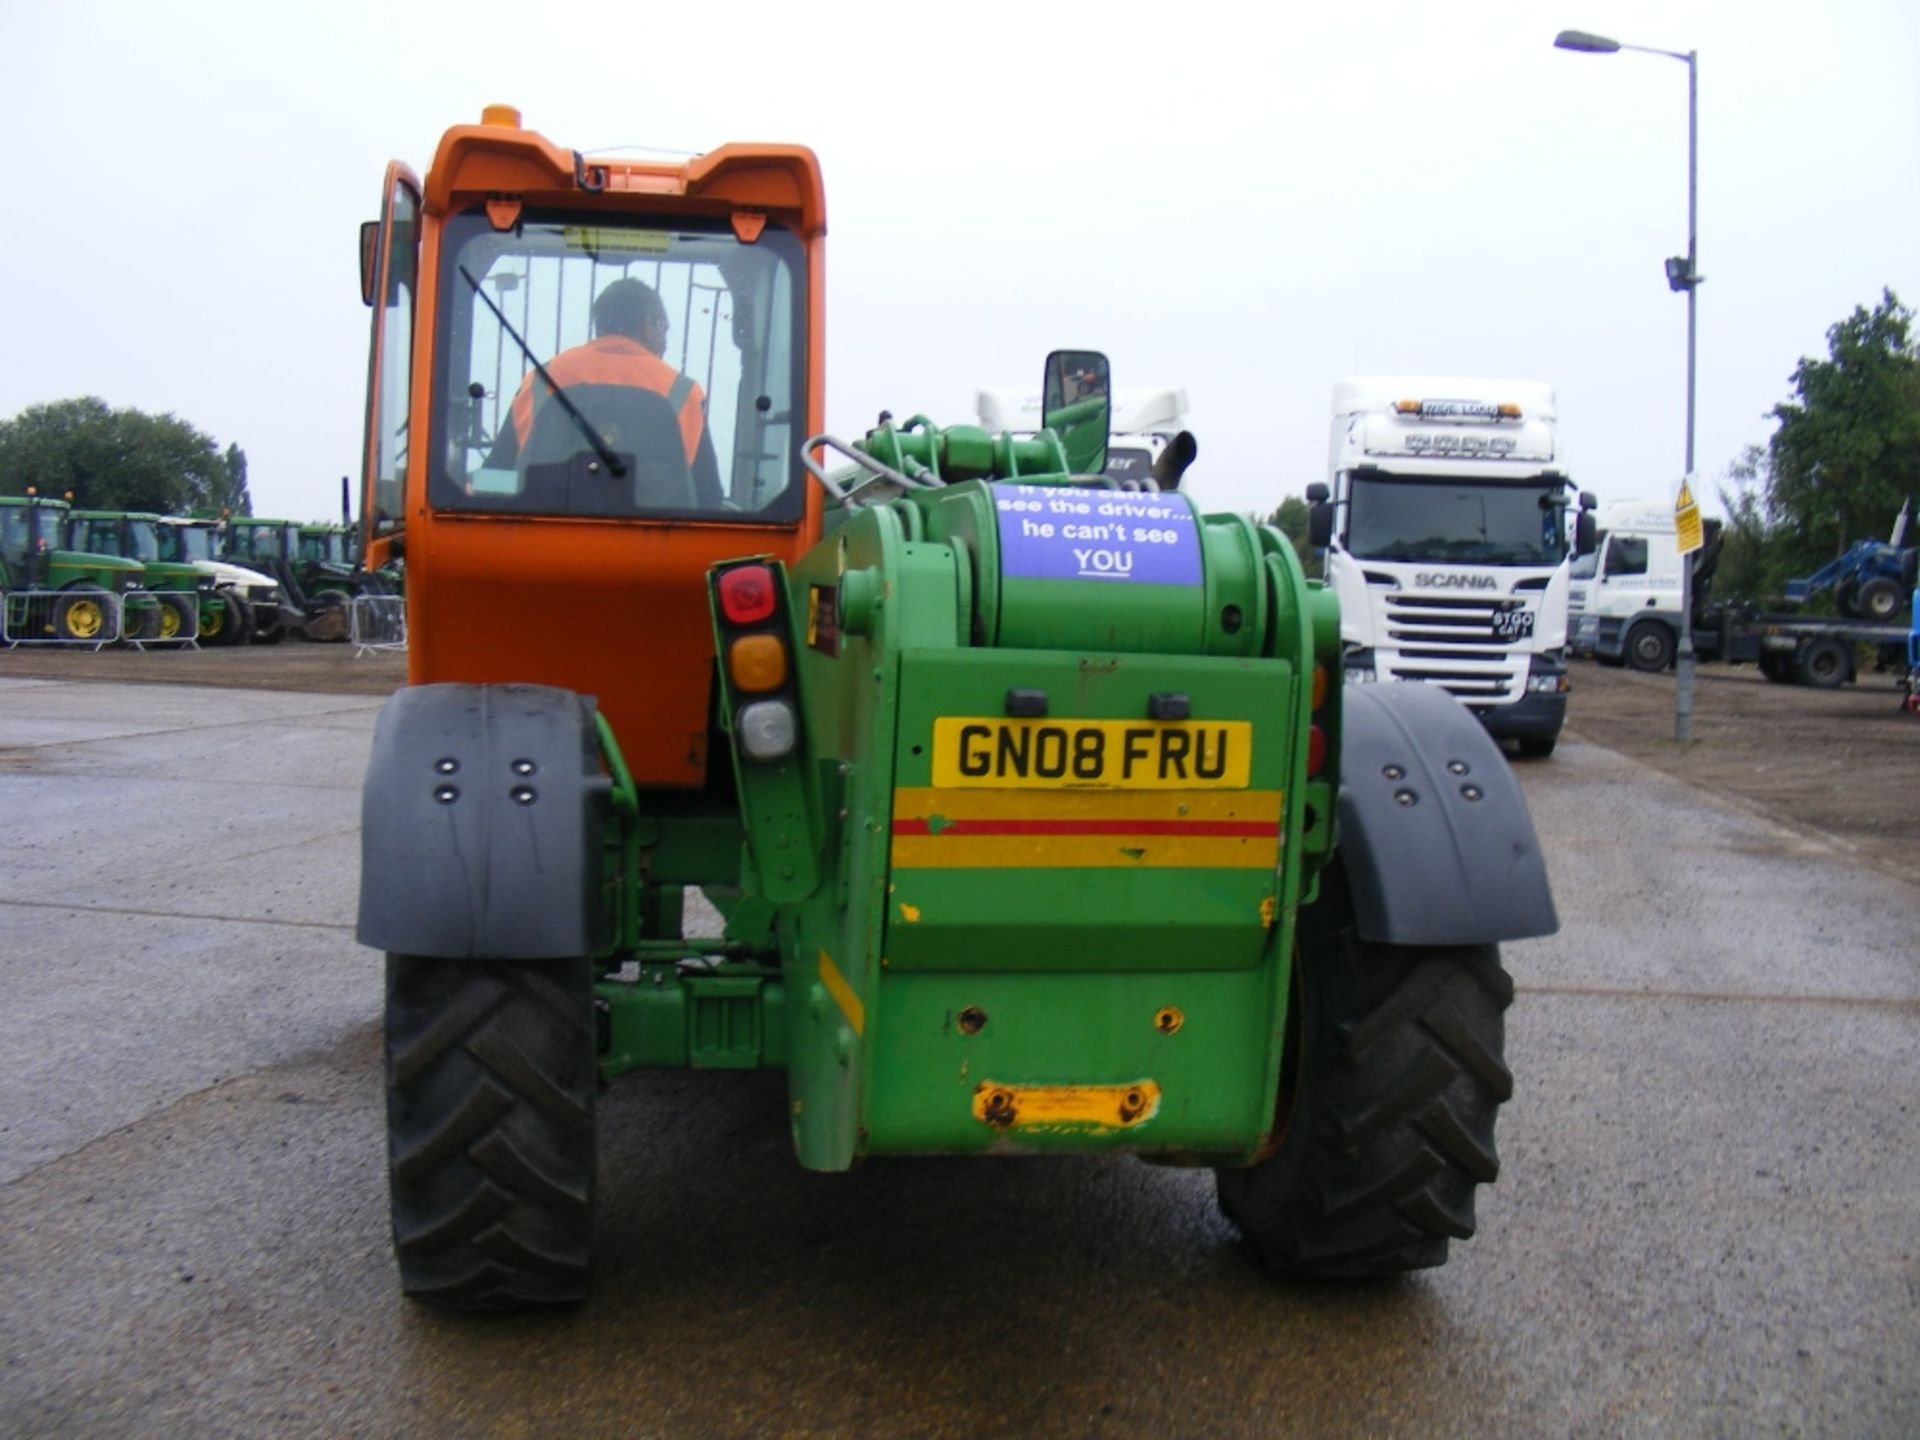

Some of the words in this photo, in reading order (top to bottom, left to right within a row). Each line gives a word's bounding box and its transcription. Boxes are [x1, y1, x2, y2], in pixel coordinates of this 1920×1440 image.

[998, 500, 1042, 512] see
[1049, 499, 1091, 515] the
[1098, 502, 1193, 520] driver...
[1022, 519, 1055, 537] he
[1062, 522, 1127, 541] can't
[1132, 529, 1178, 544] see
[1073, 549, 1133, 572] YOU
[1415, 573, 1497, 589] SCANIA
[959, 725, 1105, 778] GN08
[1122, 728, 1228, 780] FRU
